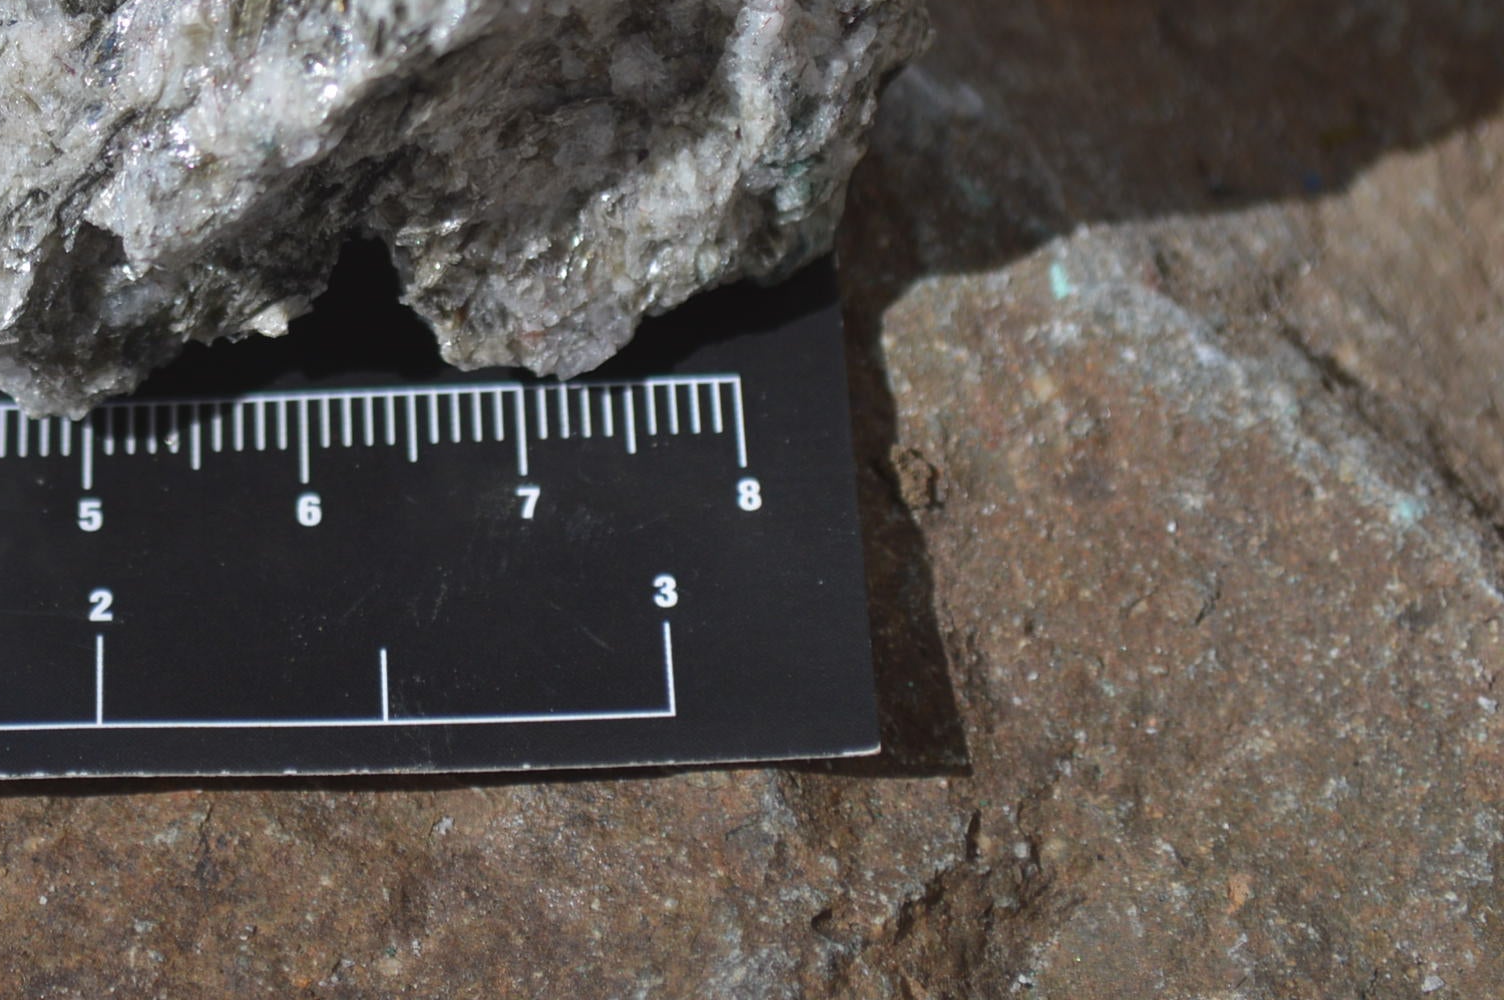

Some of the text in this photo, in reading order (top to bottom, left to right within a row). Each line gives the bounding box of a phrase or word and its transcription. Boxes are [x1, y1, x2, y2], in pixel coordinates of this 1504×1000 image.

[78, 499, 104, 533] 5
[296, 493, 322, 528] 6
[515, 485, 542, 521] 7
[736, 477, 763, 513] 8
[88, 588, 115, 623] 2
[653, 574, 680, 610] 3
